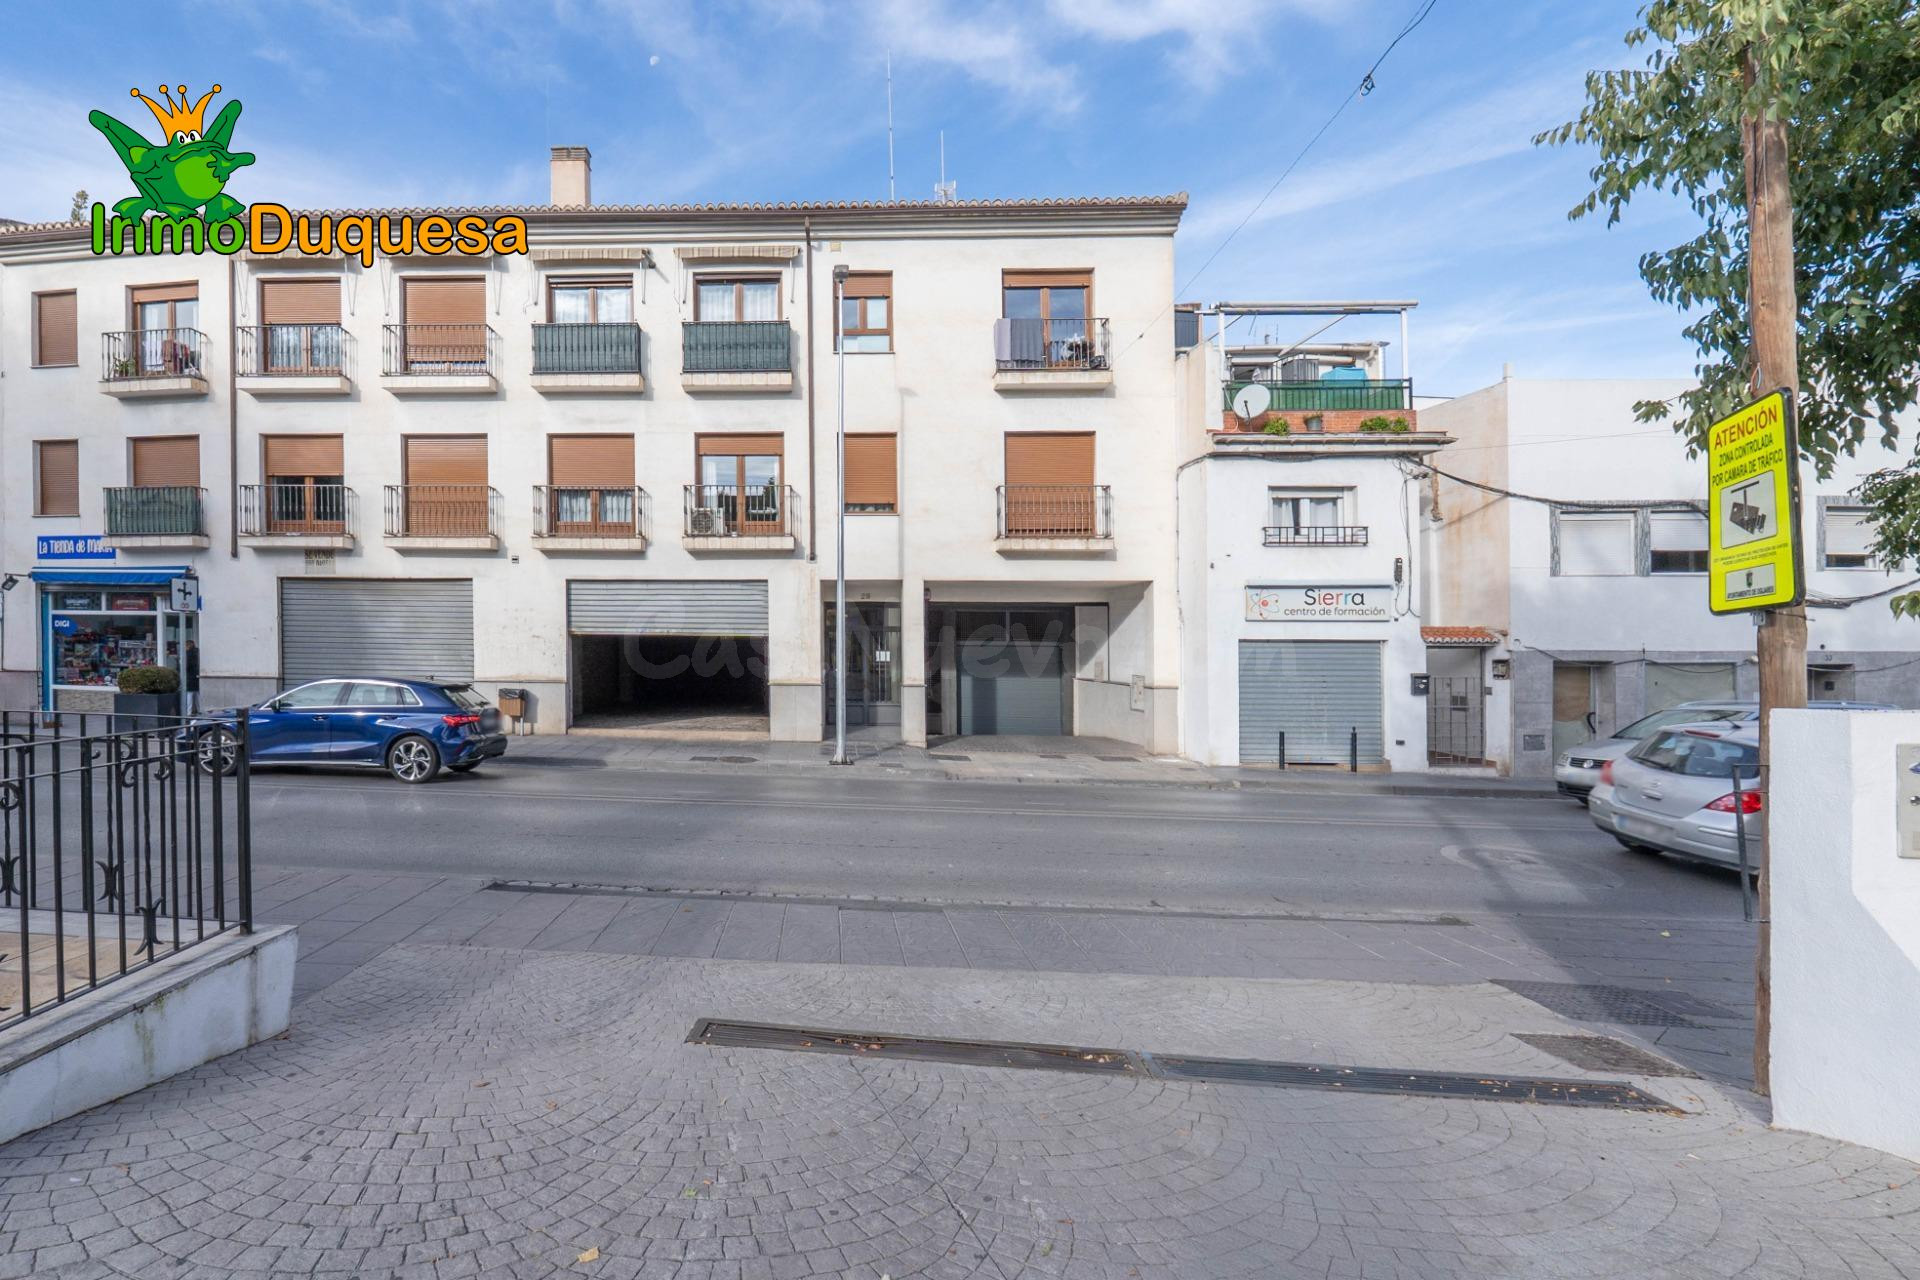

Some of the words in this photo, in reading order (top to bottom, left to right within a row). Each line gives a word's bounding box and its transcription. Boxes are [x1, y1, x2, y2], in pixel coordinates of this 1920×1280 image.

[1714, 405, 1777, 450] ATENCIÓN
[1719, 452, 1734, 467] ZONA
[1735, 432, 1774, 461] CONTROLADA
[1712, 472, 1724, 487] POR
[1749, 459, 1757, 474] DE
[76, 539, 86, 553] de
[1304, 588, 1365, 606] Sierra
[1284, 607, 1317, 616] centro
[1319, 606, 1332, 616] de
[1334, 606, 1386, 616] formación
[54, 619, 70, 628] DIGI
